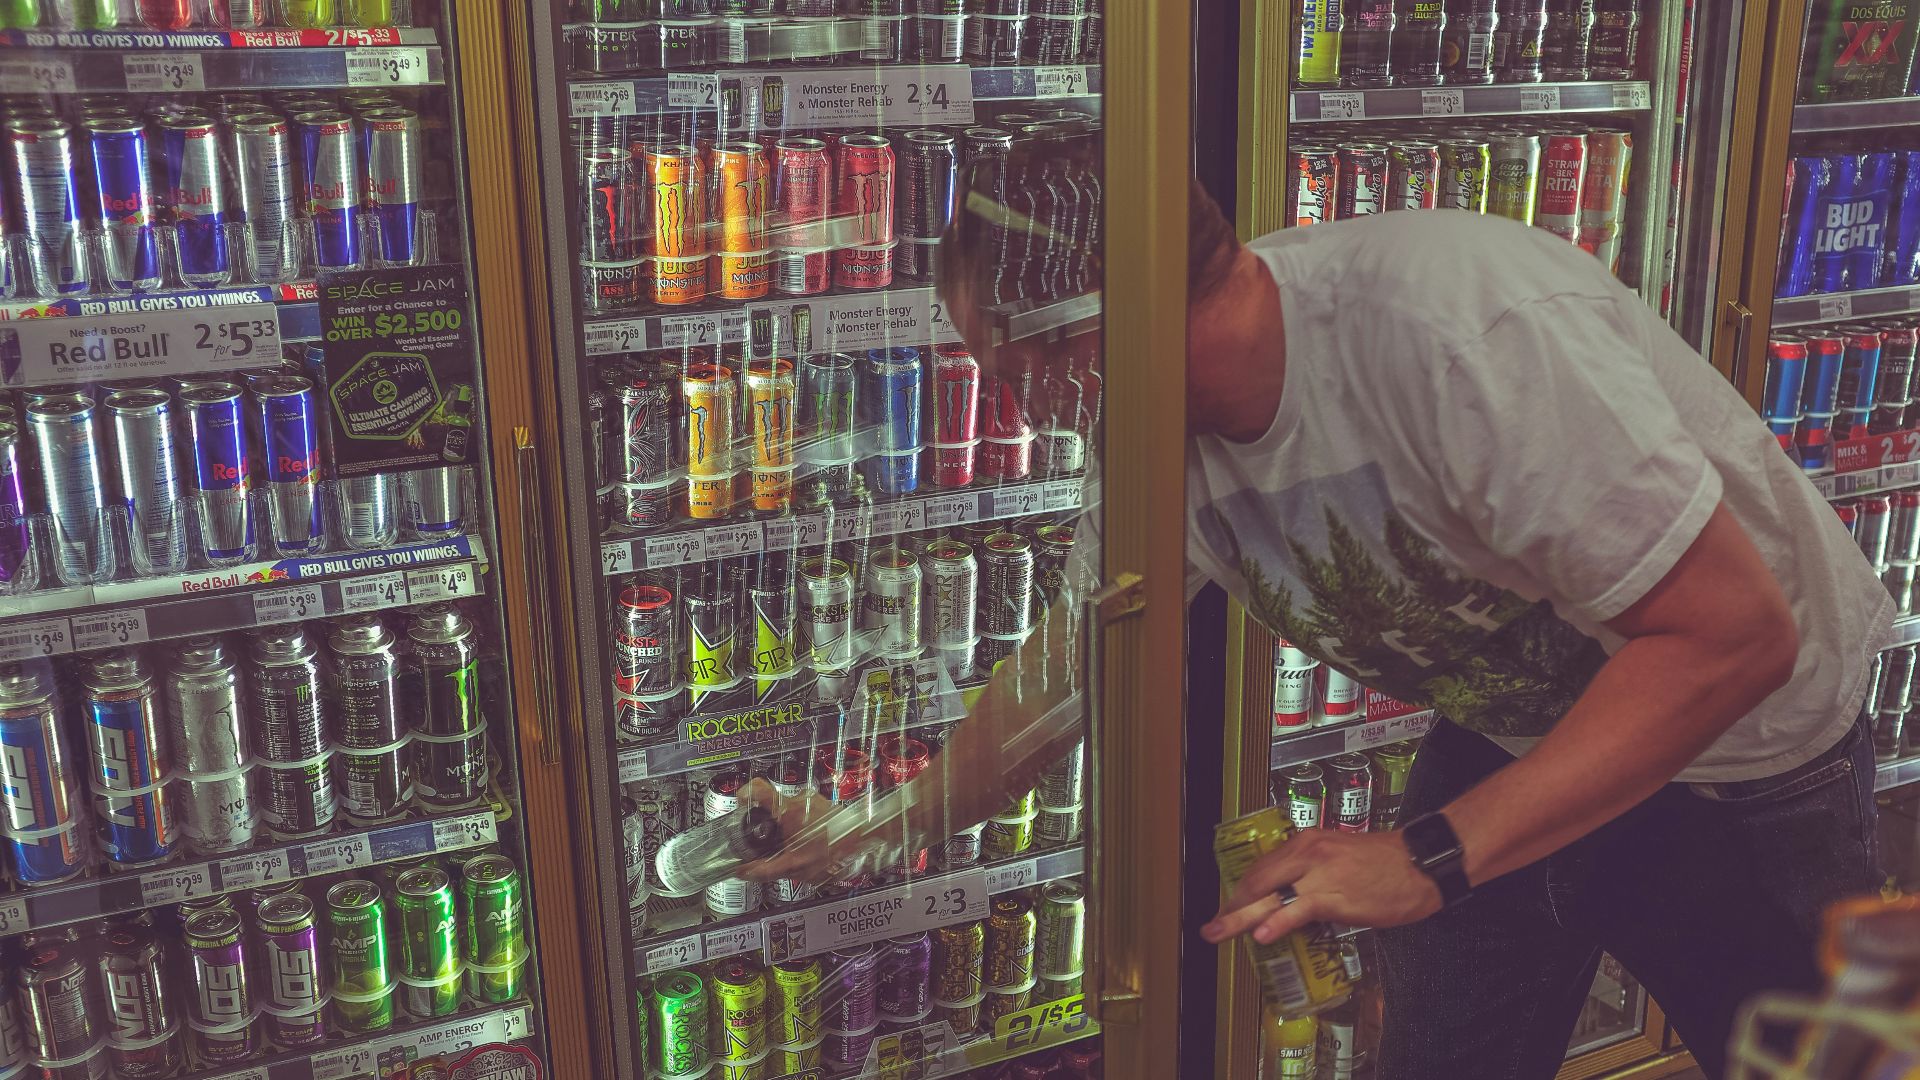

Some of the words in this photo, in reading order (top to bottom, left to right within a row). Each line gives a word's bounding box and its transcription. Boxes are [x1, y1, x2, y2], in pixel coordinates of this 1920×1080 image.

[1851, 7, 1872, 18] DOS
[1875, 5, 1906, 18] EQUIS
[27, 34, 54, 47] RED
[57, 35, 91, 47] BULL
[92, 35, 132, 48] GIVES
[134, 35, 165, 47] YOU
[246, 36, 272, 47] Red
[276, 36, 301, 47] Bull
[163, 64, 194, 89] $349
[382, 58, 410, 82] $349
[802, 84, 846, 95] Monster
[850, 82, 888, 95] Energy
[1061, 72, 1082, 94] $269
[603, 89, 629, 112] $269
[798, 102, 804, 110] &
[808, 98, 855, 109] Monster
[858, 96, 892, 108] Rehab
[906, 83, 919, 104] 2
[918, 101, 930, 112] for
[926, 84, 949, 110] $4
[1548, 159, 1580, 169] STRAW
[1545, 178, 1578, 192] RITA
[1826, 200, 1874, 228] BUD
[1815, 223, 1880, 253] LIGHT
[327, 277, 403, 299] SPACE
[410, 277, 455, 292] JAM
[80, 302, 105, 316] RED
[109, 300, 139, 314] BULL
[140, 298, 177, 312] GIVES
[180, 296, 206, 309] YOU
[338, 306, 366, 315] Enter
[368, 304, 383, 312] for
[394, 301, 432, 310] Chance
[435, 299, 447, 307] to
[829, 307, 876, 320] Monster
[876, 305, 912, 318] Energy
[930, 303, 943, 323] 2
[69, 327, 98, 339] Need
[110, 324, 146, 335] Boost?
[326, 327, 373, 342] OVER
[374, 309, 461, 338] $2,500
[331, 315, 365, 329] WIN
[692, 321, 716, 343] $269
[826, 327, 832, 335] &
[835, 320, 883, 333] Monster
[884, 318, 916, 329] Rehab
[49, 340, 107, 366] Red
[113, 333, 169, 361] Bull
[194, 323, 213, 350] 2
[213, 345, 231, 359] for
[395, 338, 417, 346] Worth
[427, 333, 460, 343] Essential
[402, 344, 435, 352] Camping
[435, 341, 454, 349] Gear
[614, 328, 639, 350] $269
[392, 361, 422, 374] JAM
[349, 405, 390, 423] ULTIMATE
[391, 386, 429, 413] CAMPING
[351, 413, 397, 433] ESSENTIALS
[397, 393, 433, 420] GIVEAWAY
[1837, 446, 1858, 458] MIX
[1861, 445, 1867, 454] &
[1881, 436, 1894, 464] 2
[213, 456, 248, 481] Red
[1837, 457, 1868, 468] MATCH
[952, 501, 973, 522] $269
[1018, 492, 1038, 513] $269
[899, 508, 920, 529] $269
[676, 541, 700, 562] $269
[735, 530, 758, 551] $269
[299, 563, 322, 577] RED
[324, 560, 351, 574] BULL
[351, 556, 385, 570] GIVES
[388, 553, 411, 566] YOU
[602, 550, 627, 573] $269
[182, 579, 211, 593] Red
[211, 574, 240, 589] Bull
[378, 580, 405, 603] $499
[441, 571, 467, 594] $499
[290, 593, 316, 617] $399
[111, 618, 139, 643] $399
[34, 631, 64, 655] $349
[1361, 726, 1385, 738] 2/$3.50
[1404, 714, 1428, 728] 2/$3.50
[698, 734, 751, 752] ENERGY
[755, 726, 798, 743] DRINK
[465, 819, 490, 842] $349
[337, 842, 363, 865] $349
[255, 857, 282, 880] $269
[1012, 868, 1032, 886] $219
[175, 873, 203, 896] $299
[827, 897, 904, 925] ROCKSTAR
[924, 895, 938, 916] 2
[937, 908, 950, 921] for
[944, 887, 967, 915] $3
[839, 913, 893, 936] ENERGY
[330, 933, 377, 950] AMP
[733, 930, 755, 951] $219
[674, 943, 696, 963] $219
[419, 1027, 446, 1045] AMP
[447, 1021, 486, 1039] ENERGY
[1005, 1002, 1089, 1051] 2/$3
[345, 1050, 370, 1073] $219
